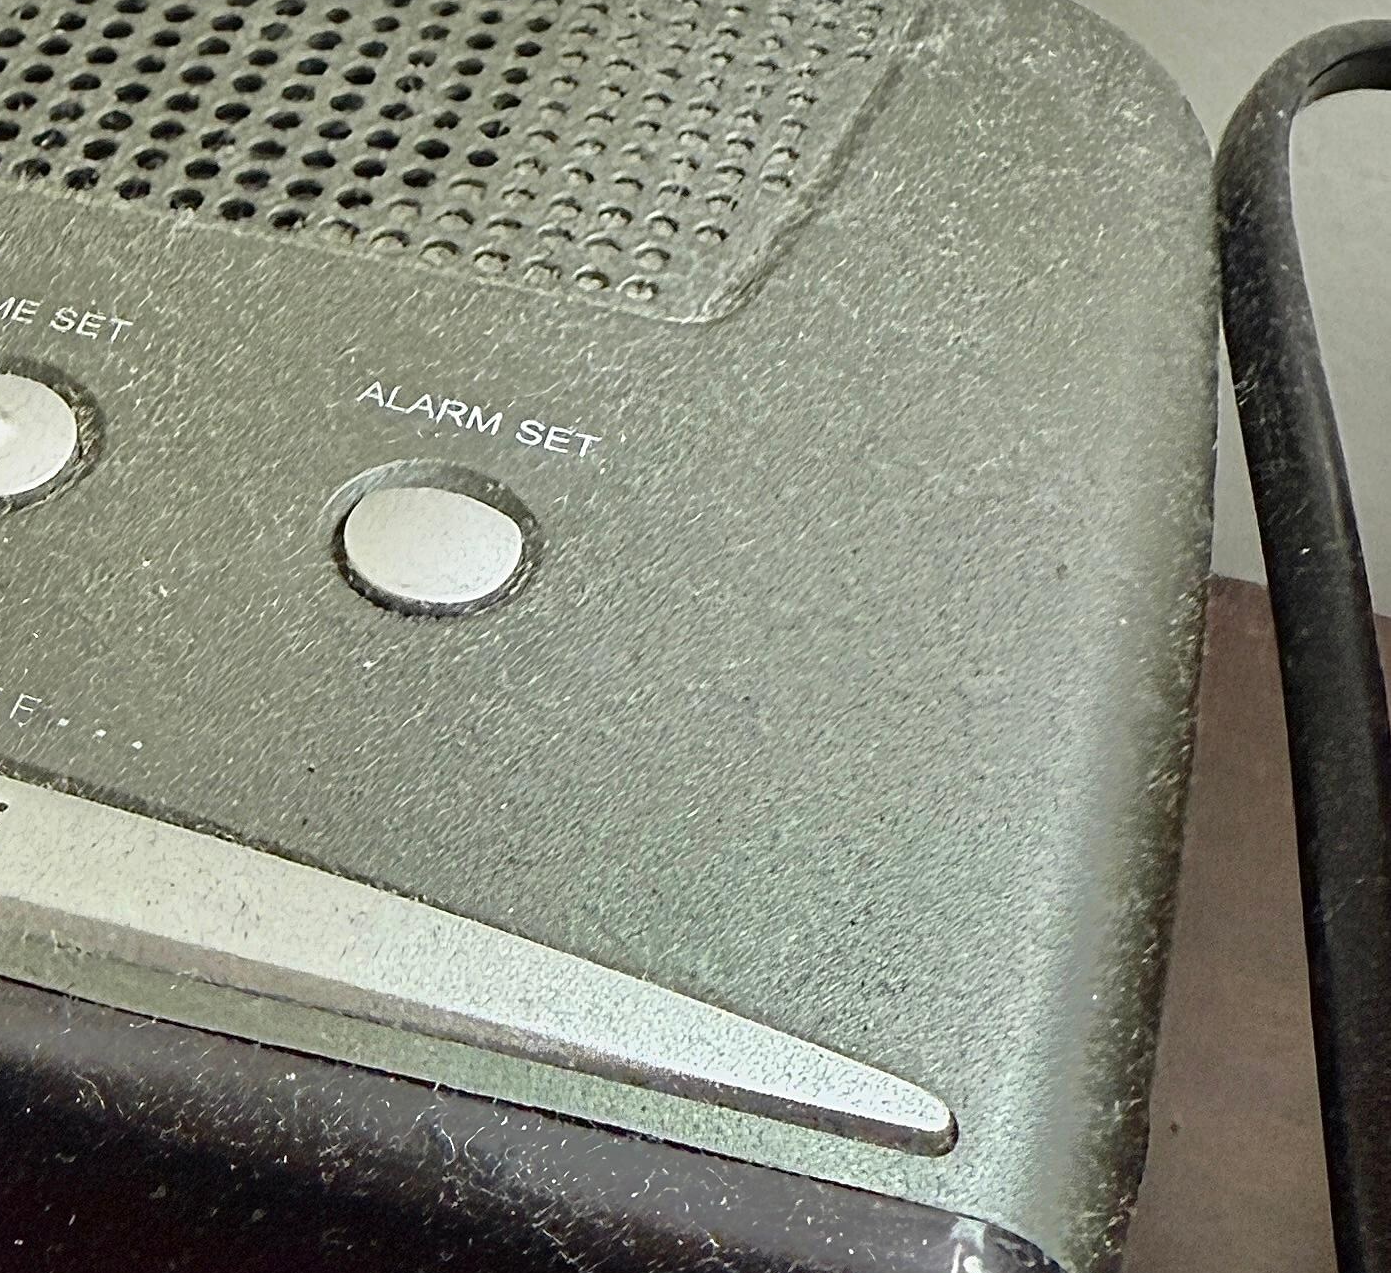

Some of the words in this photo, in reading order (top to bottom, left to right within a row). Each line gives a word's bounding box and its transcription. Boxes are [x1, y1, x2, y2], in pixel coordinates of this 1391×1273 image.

[49, 305, 134, 345] SET
[356, 379, 505, 438] ALARM
[514, 417, 603, 461] SET
